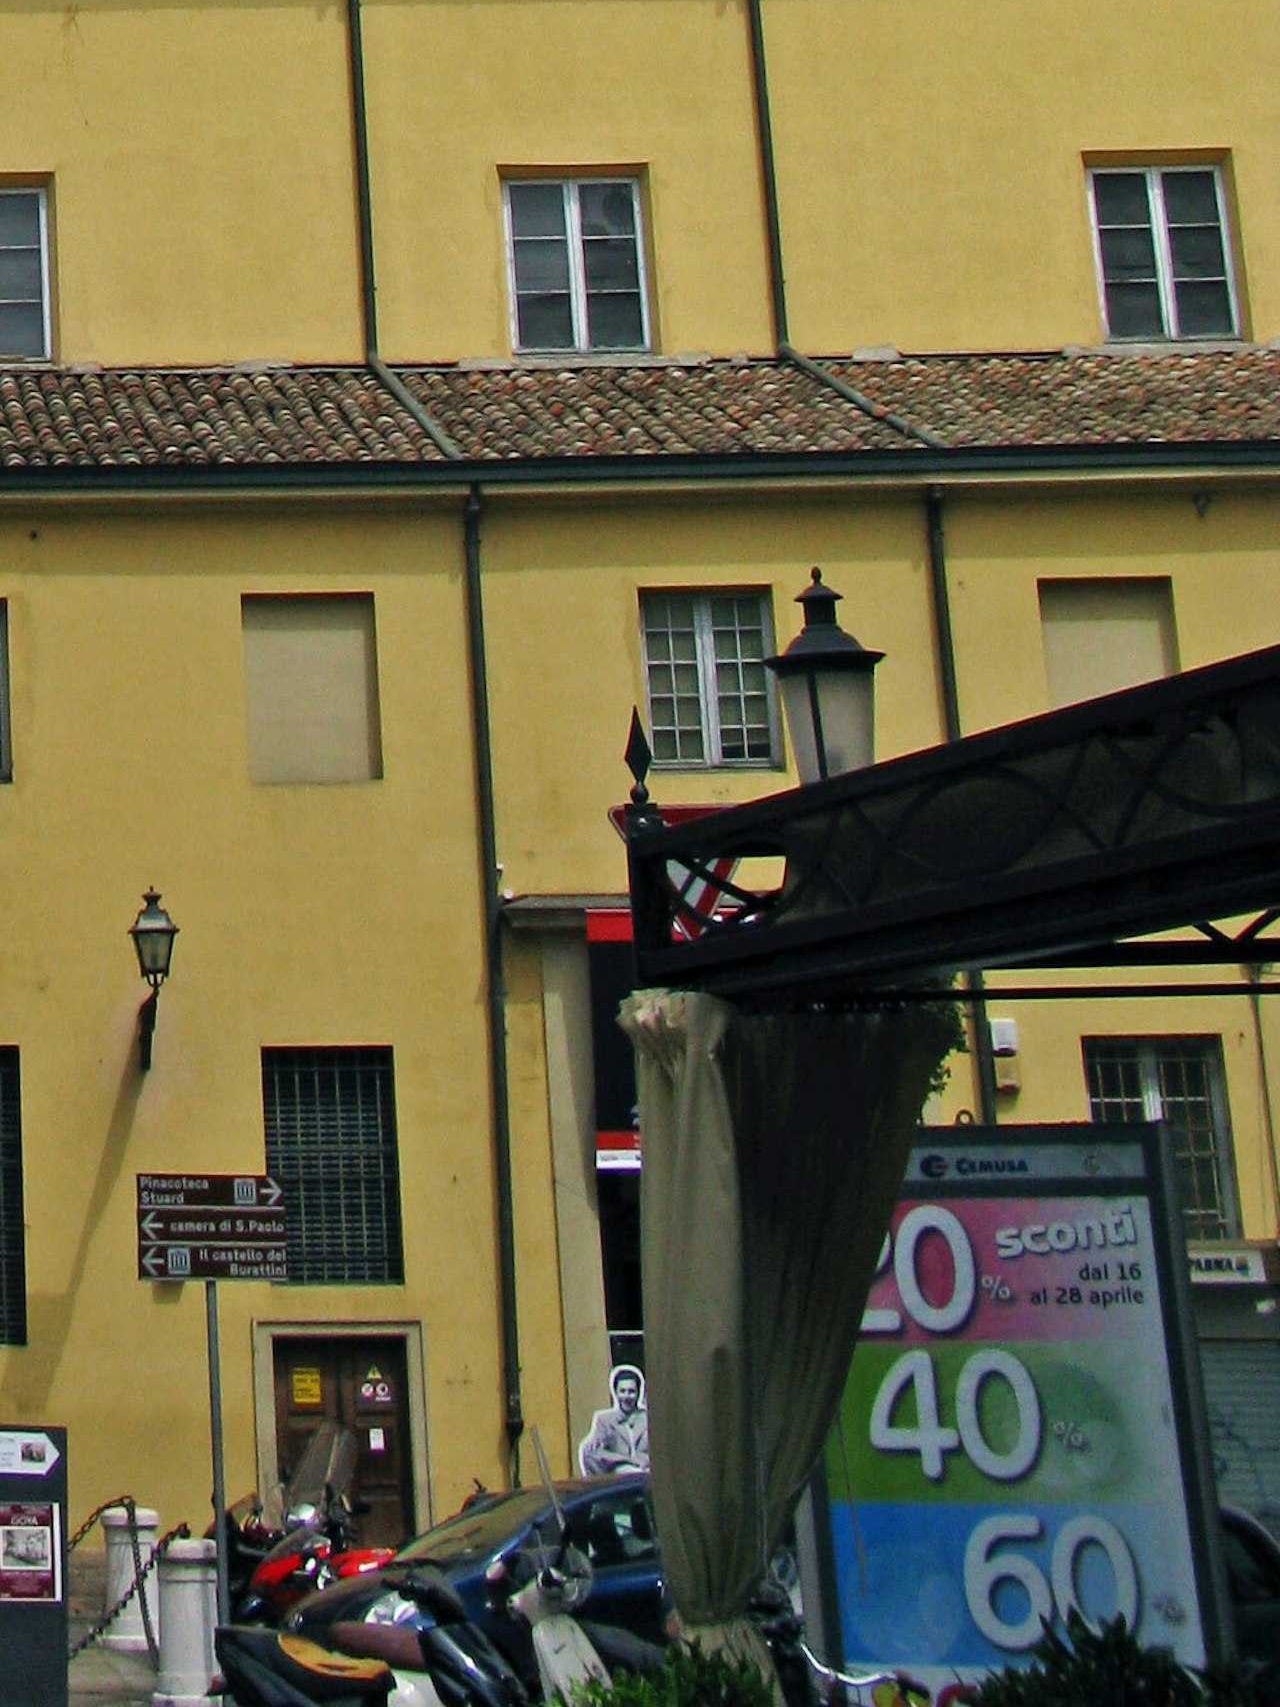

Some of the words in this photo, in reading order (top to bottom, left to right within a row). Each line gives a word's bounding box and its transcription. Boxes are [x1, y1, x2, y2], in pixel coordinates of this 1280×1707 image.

[140, 1176, 209, 1190] Pinacoteca
[141, 1192, 184, 1204] Stuard
[170, 1221, 215, 1232] camera
[220, 1220, 231, 1232] di
[995, 1205, 1138, 1259] sconti
[213, 1249, 262, 1261] castello
[230, 1263, 286, 1275] Burattini
[1079, 1264, 1110, 1281] dal
[1116, 1263, 1141, 1280] 16
[1030, 1290, 1048, 1305] al
[1057, 1289, 1083, 1304] 28
[1088, 1288, 1144, 1309] aprile
[870, 1348, 1042, 1480] 40
[964, 1514, 1138, 1652] 60
